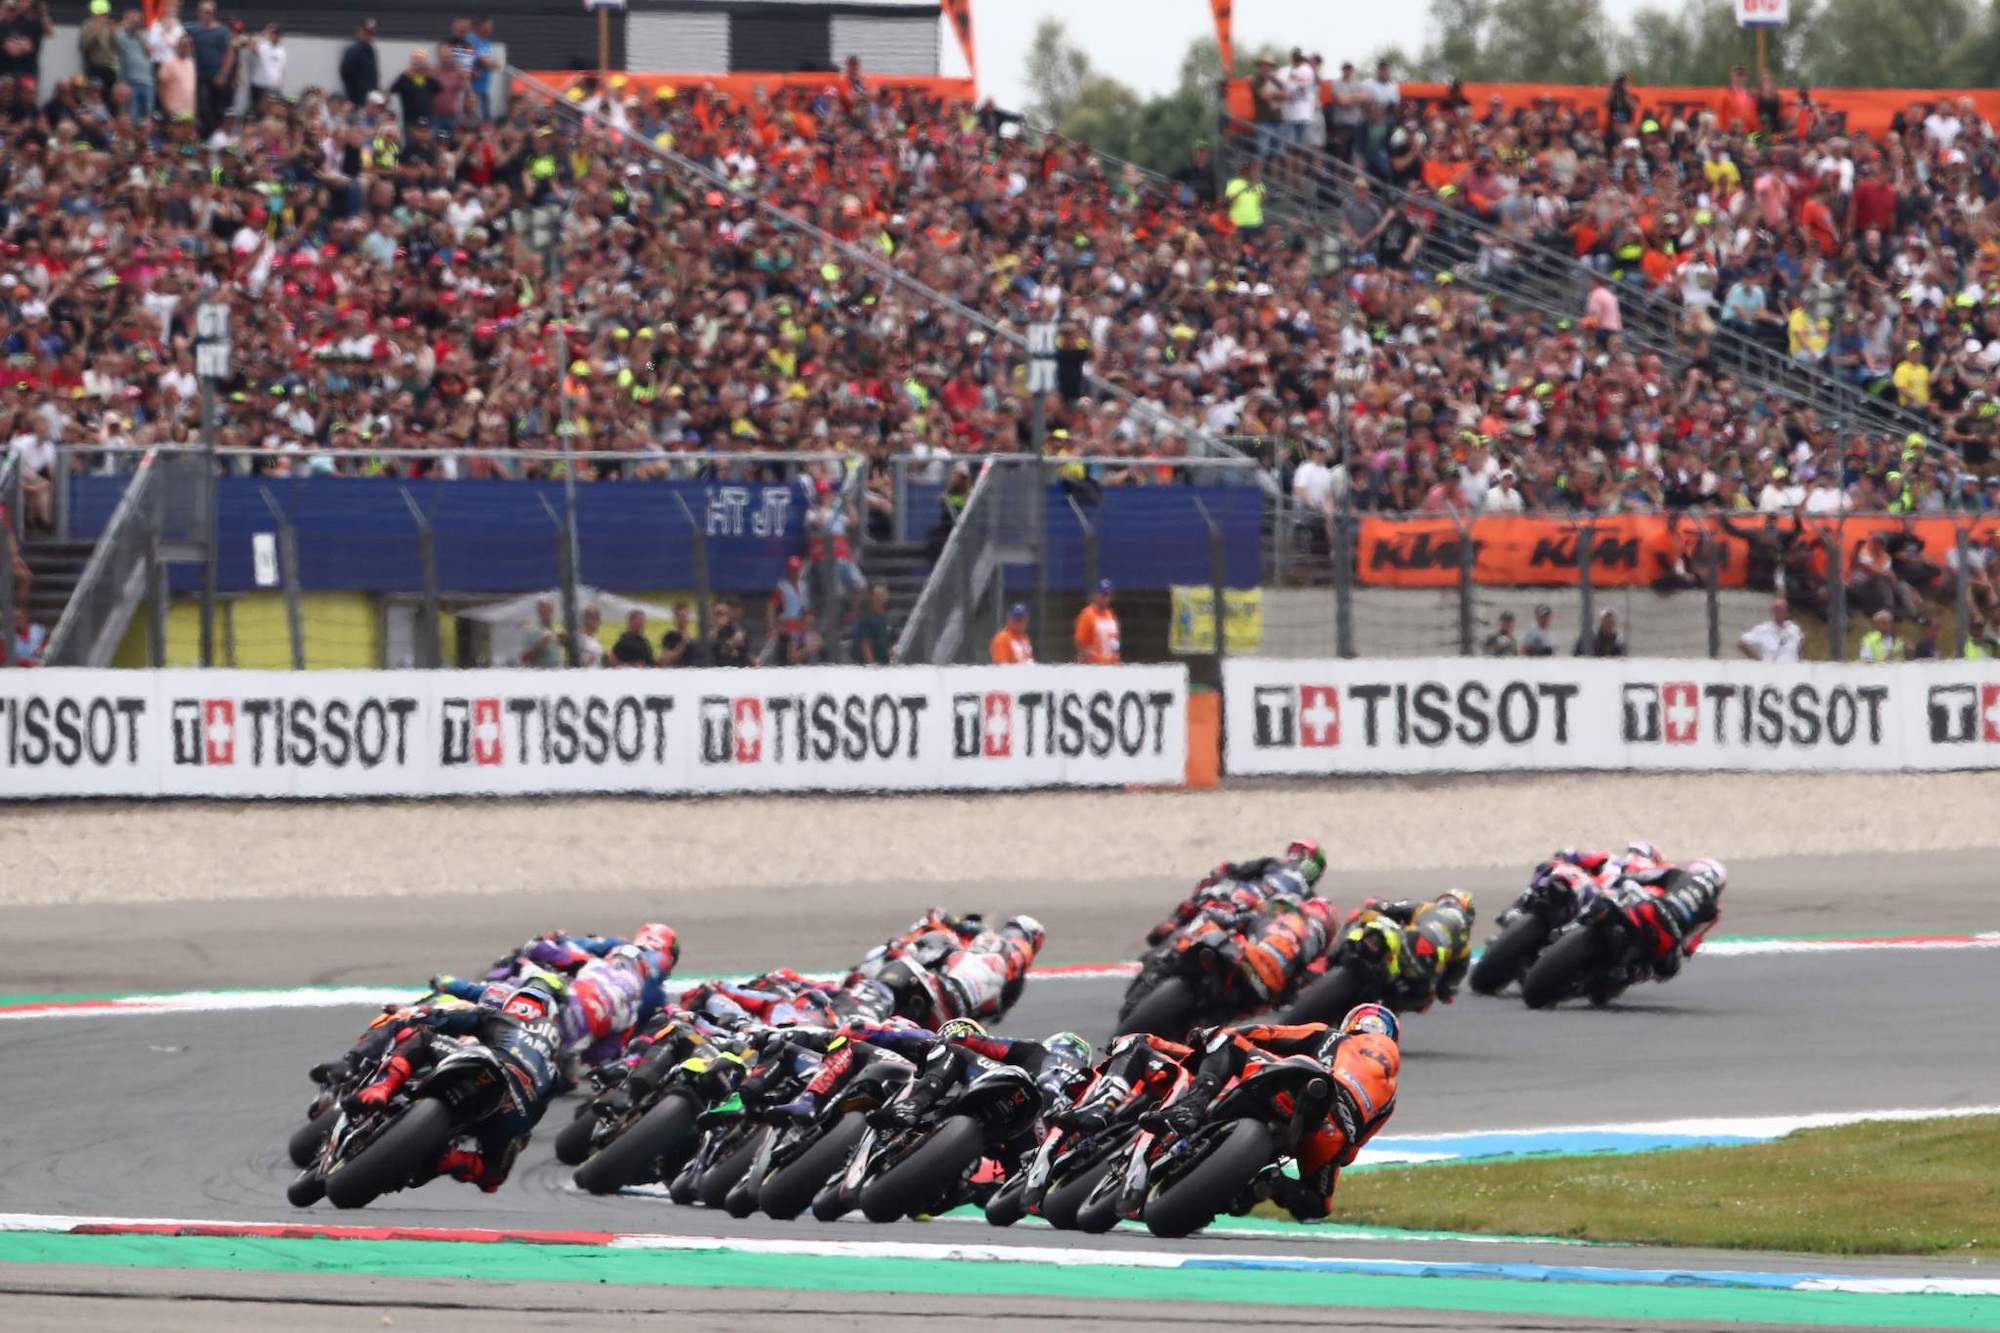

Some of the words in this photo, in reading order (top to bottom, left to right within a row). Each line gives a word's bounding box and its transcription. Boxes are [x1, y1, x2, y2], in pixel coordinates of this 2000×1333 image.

[0, 697, 146, 767] ISSOT
[242, 698, 419, 768] TISSOT
[507, 695, 674, 765] TISSOT
[767, 694, 928, 763] TISSOT
[1018, 691, 1174, 759] TISSOT
[1348, 681, 1579, 748] TISSOT
[1704, 683, 1889, 747] TISSOT
